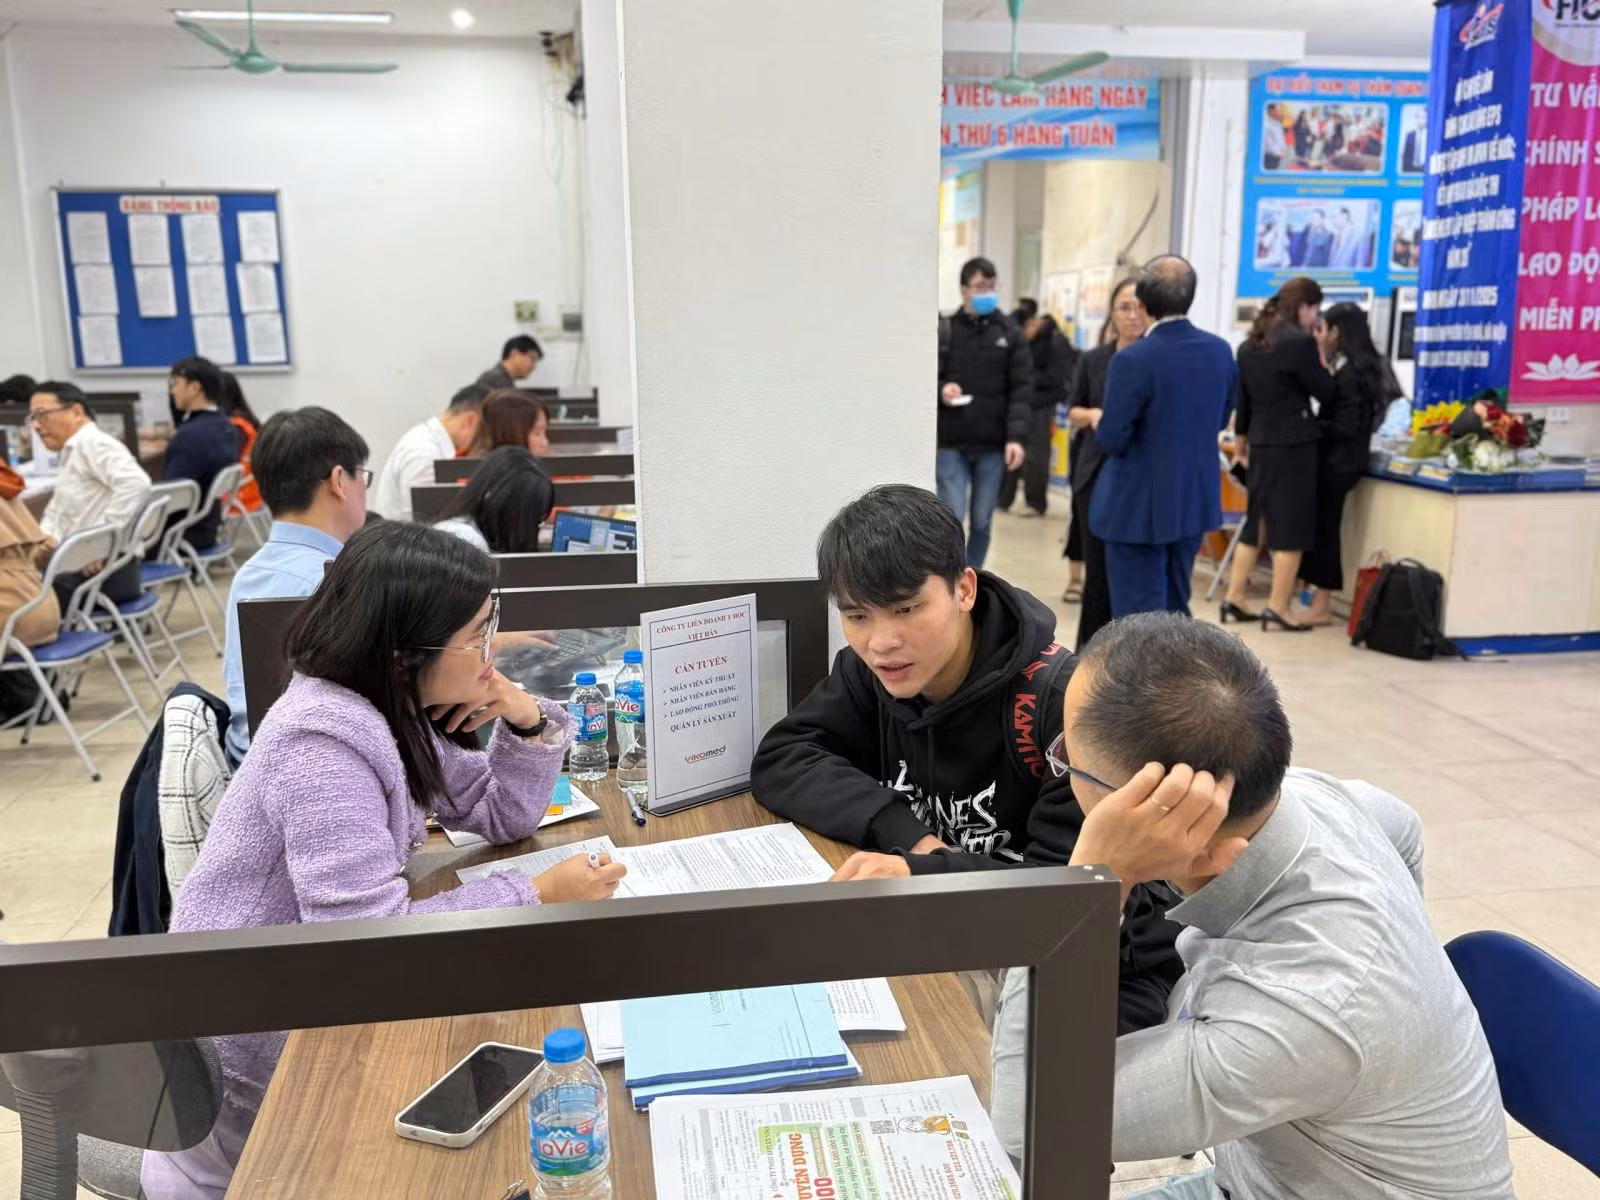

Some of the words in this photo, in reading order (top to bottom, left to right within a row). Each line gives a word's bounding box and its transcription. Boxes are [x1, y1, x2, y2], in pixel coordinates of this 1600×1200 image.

[1100, 80, 1147, 108] NGÀY
[1531, 83, 1563, 107] TƯ
[1568, 73, 1600, 109] VẤ
[1013, 118, 1062, 147] HÀNG
[1069, 117, 1114, 147] TUẦN
[1521, 191, 1579, 222] PHÁP
[1585, 197, 1600, 220] L
[1518, 251, 1562, 277] LAO
[1519, 298, 1574, 330] MIỄN
[656, 623, 676, 634] CÔNG
[677, 622, 688, 631] TY
[687, 618, 703, 628] LIÊN
[703, 614, 726, 625] DOANH
[725, 613, 733, 622] Y
[732, 610, 747, 621] HỌC
[687, 630, 704, 641] VIỆT
[703, 628, 719, 638] HÀN
[669, 682, 688, 693] NHÂN
[688, 679, 704, 690] VIÊN
[714, 672, 736, 683] THUẬT
[669, 694, 688, 706] NHÂN
[689, 691, 704, 701] VIÊN
[704, 687, 718, 697] BÁN
[718, 684, 737, 695] HÀNG
[670, 708, 684, 718] LAO
[684, 704, 703, 715] ĐỘNG
[718, 695, 740, 706] THÔNG
[717, 710, 737, 722] XUẤT
[788, 1133, 809, 1165] DỤNG
